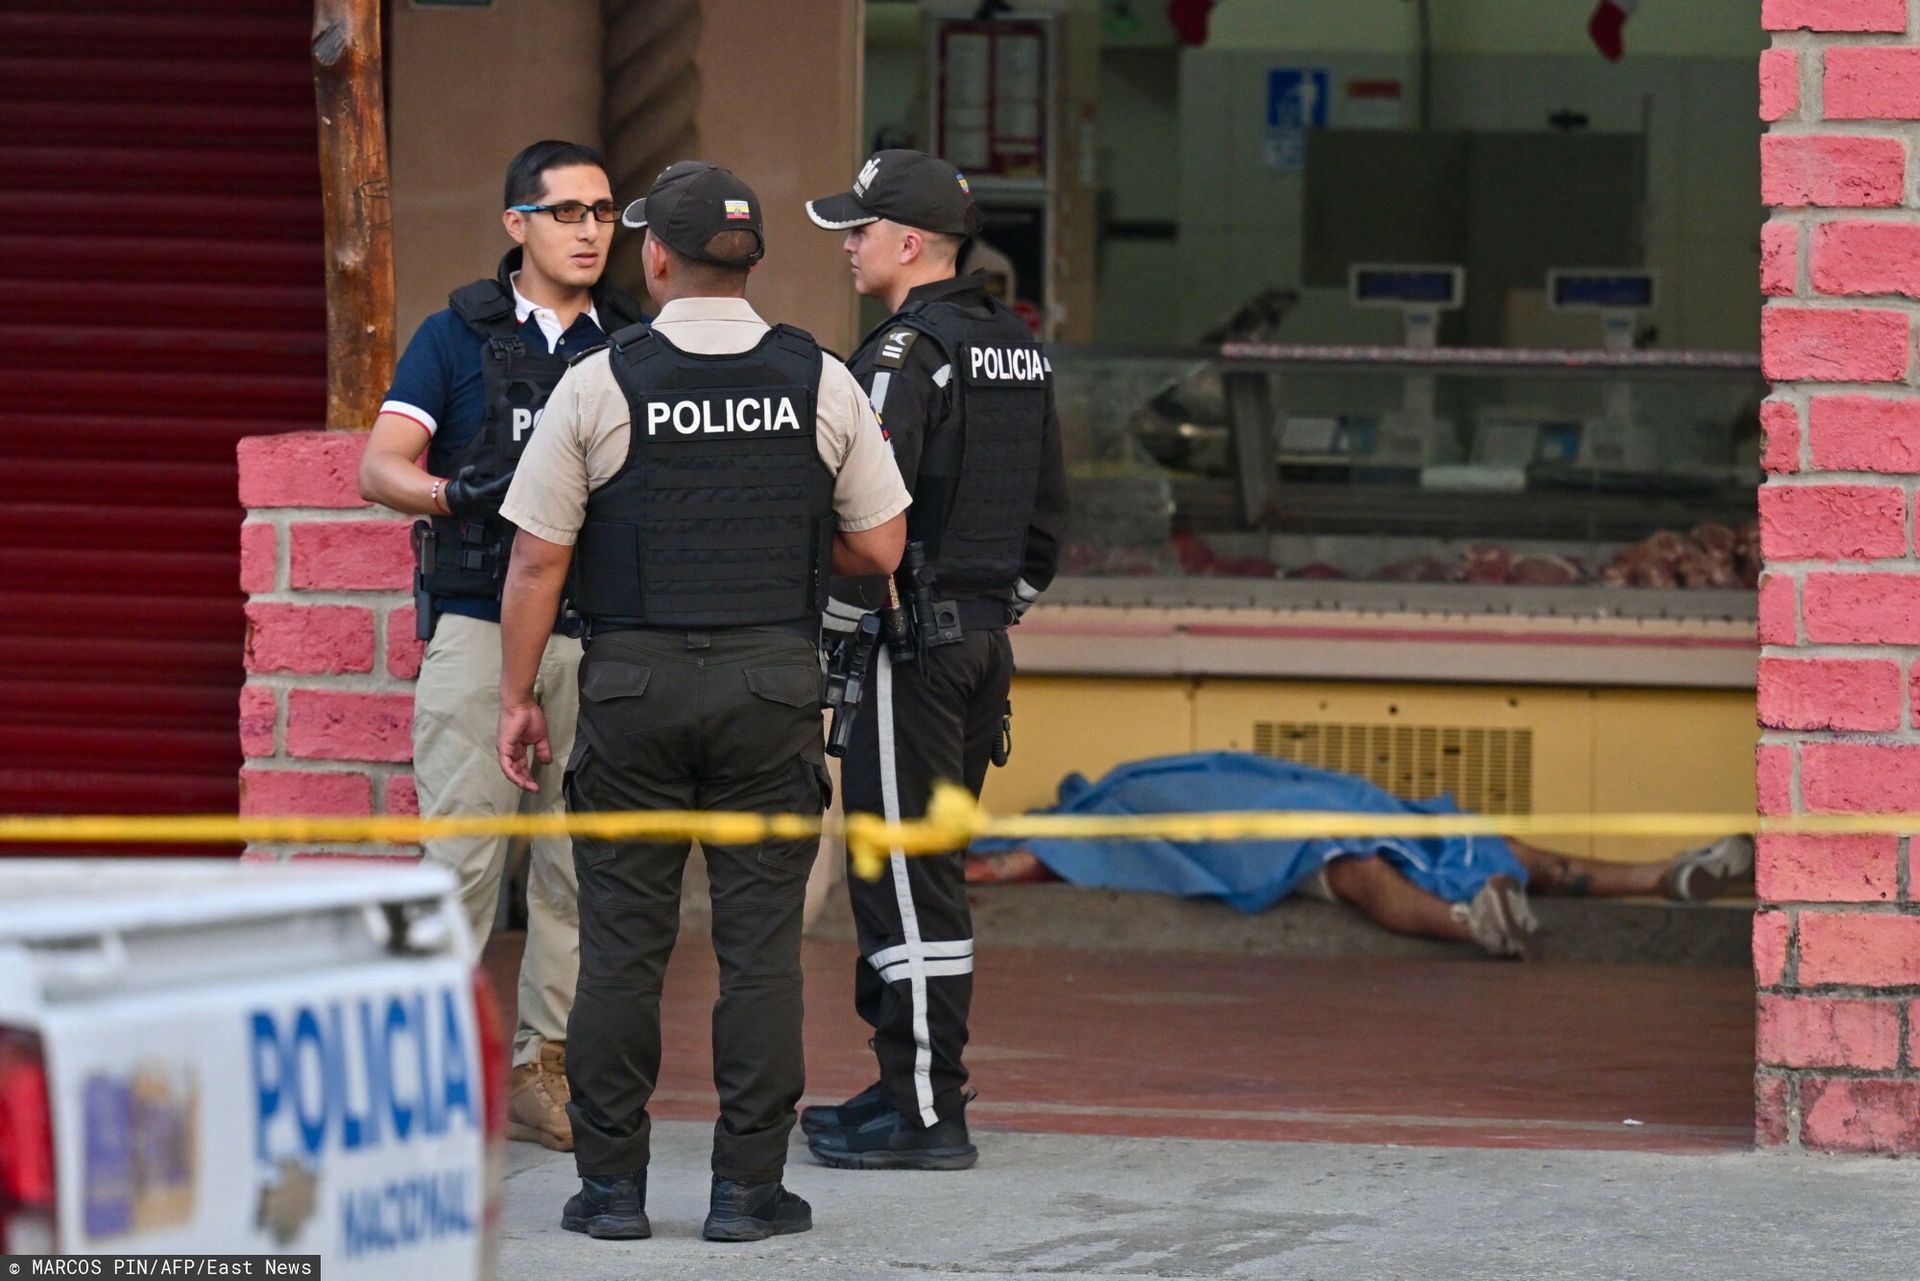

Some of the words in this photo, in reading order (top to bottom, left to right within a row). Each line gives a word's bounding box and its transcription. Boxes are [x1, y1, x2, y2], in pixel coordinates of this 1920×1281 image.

[970, 347, 1044, 381] POLICIA
[647, 397, 800, 435] POLICIA
[250, 987, 480, 1162] POLICIA
